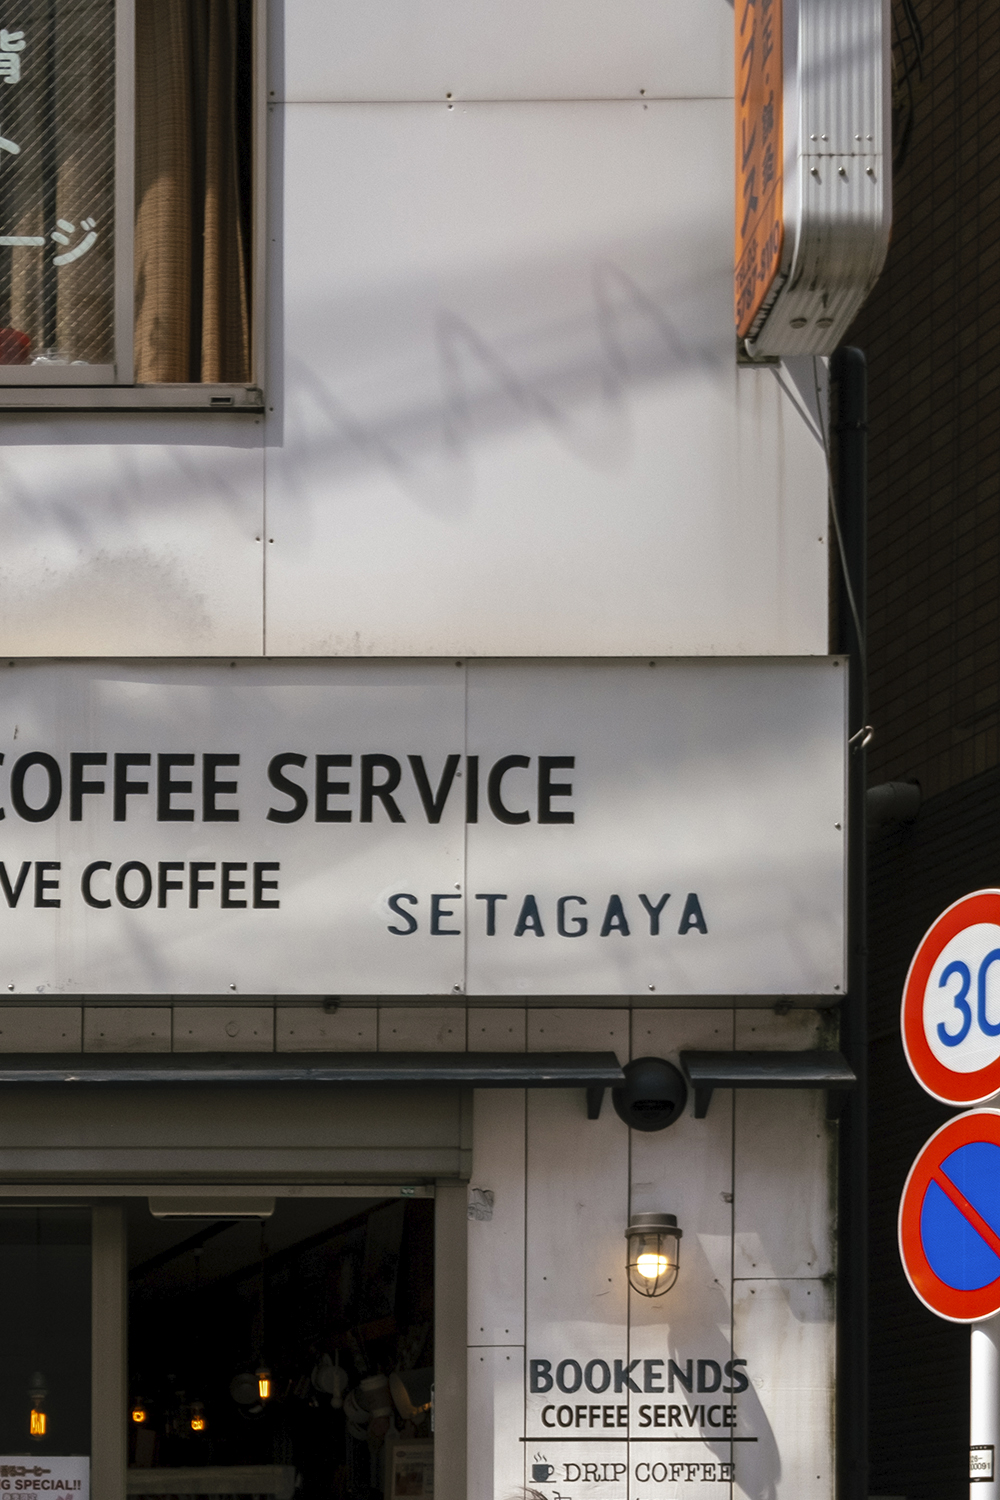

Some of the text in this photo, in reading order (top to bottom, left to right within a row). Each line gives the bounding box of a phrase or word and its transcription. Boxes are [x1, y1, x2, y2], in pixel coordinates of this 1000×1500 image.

[266, 752, 575, 825] SERVICE
[81, 860, 280, 909] COFFEE
[387, 892, 708, 937] SETAGAYA
[936, 948, 1000, 1047] 30
[529, 1358, 749, 1394] BOOKENDS
[541, 1404, 737, 1428] COFFEE SERVICE
[14, 1479, 81, 1491] SPECIAL!!
[563, 1463, 736, 1484] DRIP COFFEE
